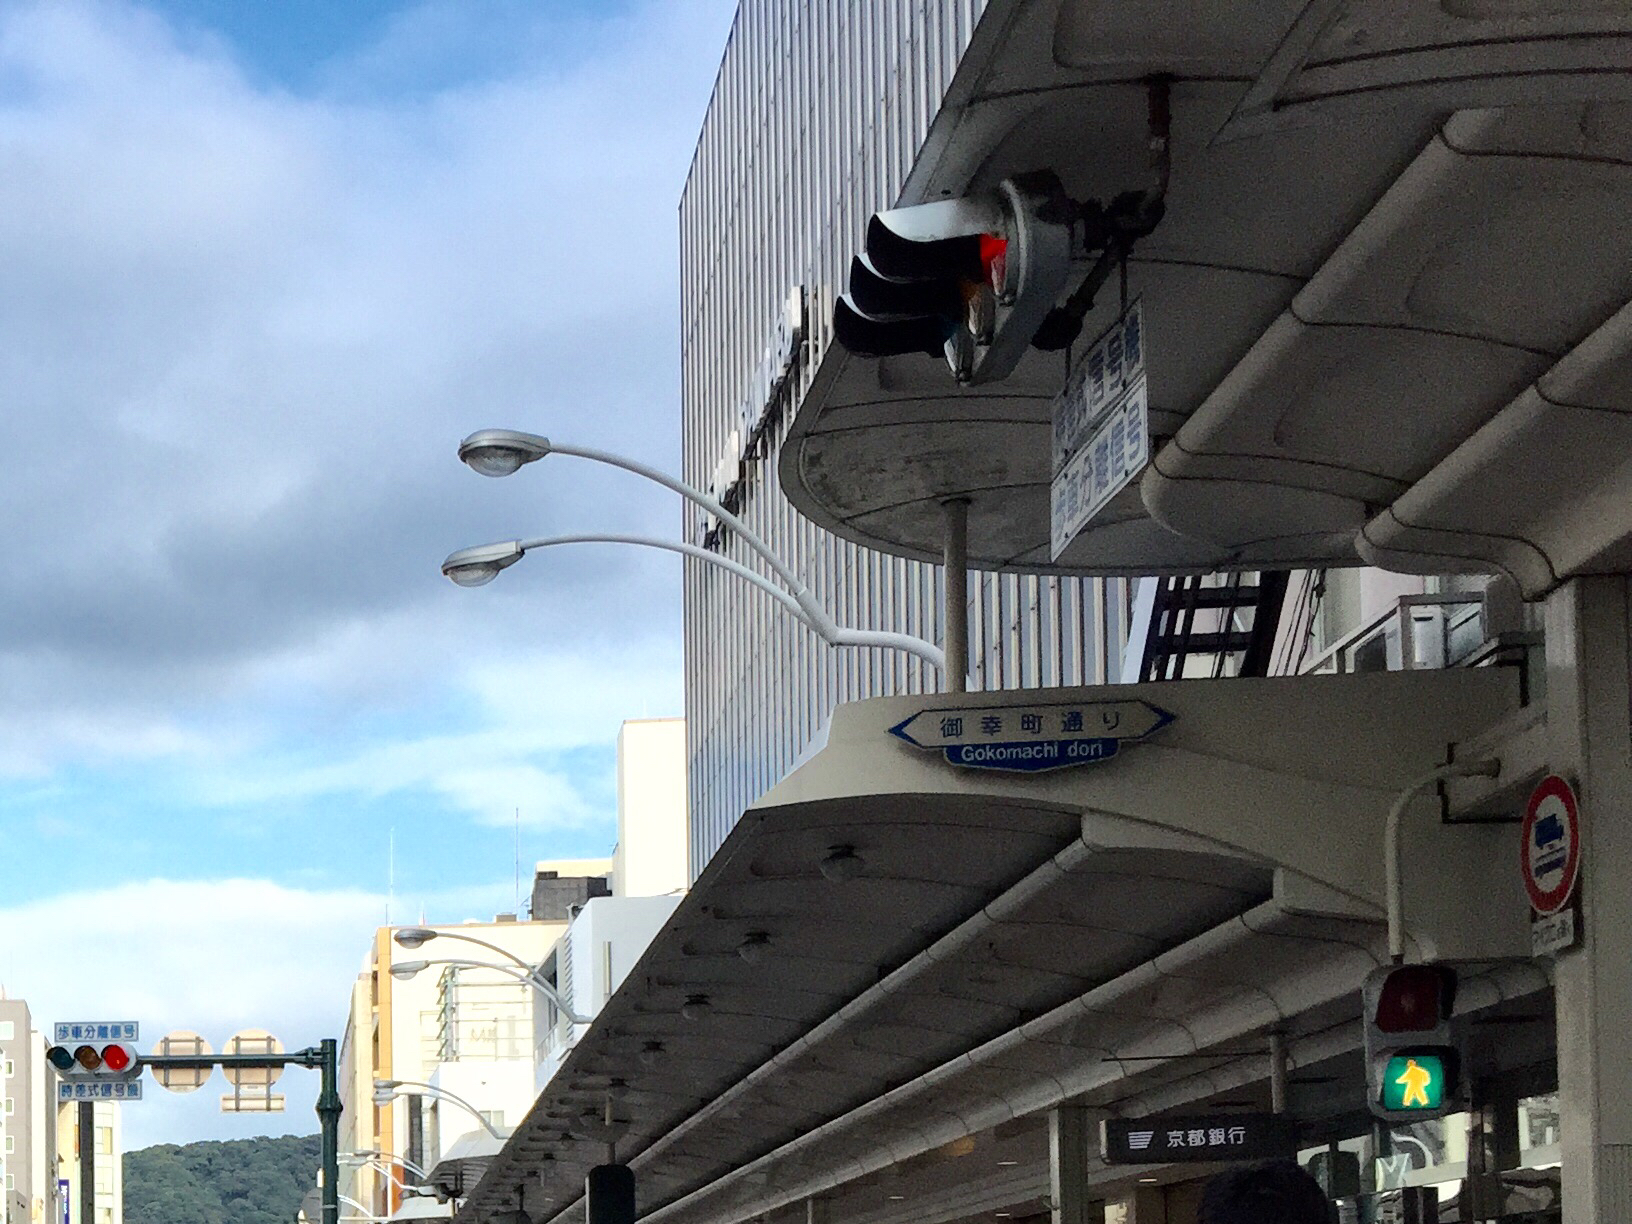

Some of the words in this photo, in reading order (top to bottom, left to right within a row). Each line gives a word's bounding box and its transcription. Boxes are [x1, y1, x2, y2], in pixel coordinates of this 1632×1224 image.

[940, 711, 1120, 738] 御幸町通り
[961, 742, 1060, 762] Gokomachi
[1068, 739, 1104, 757] dori
[1166, 1126, 1246, 1148] 京都銀行
